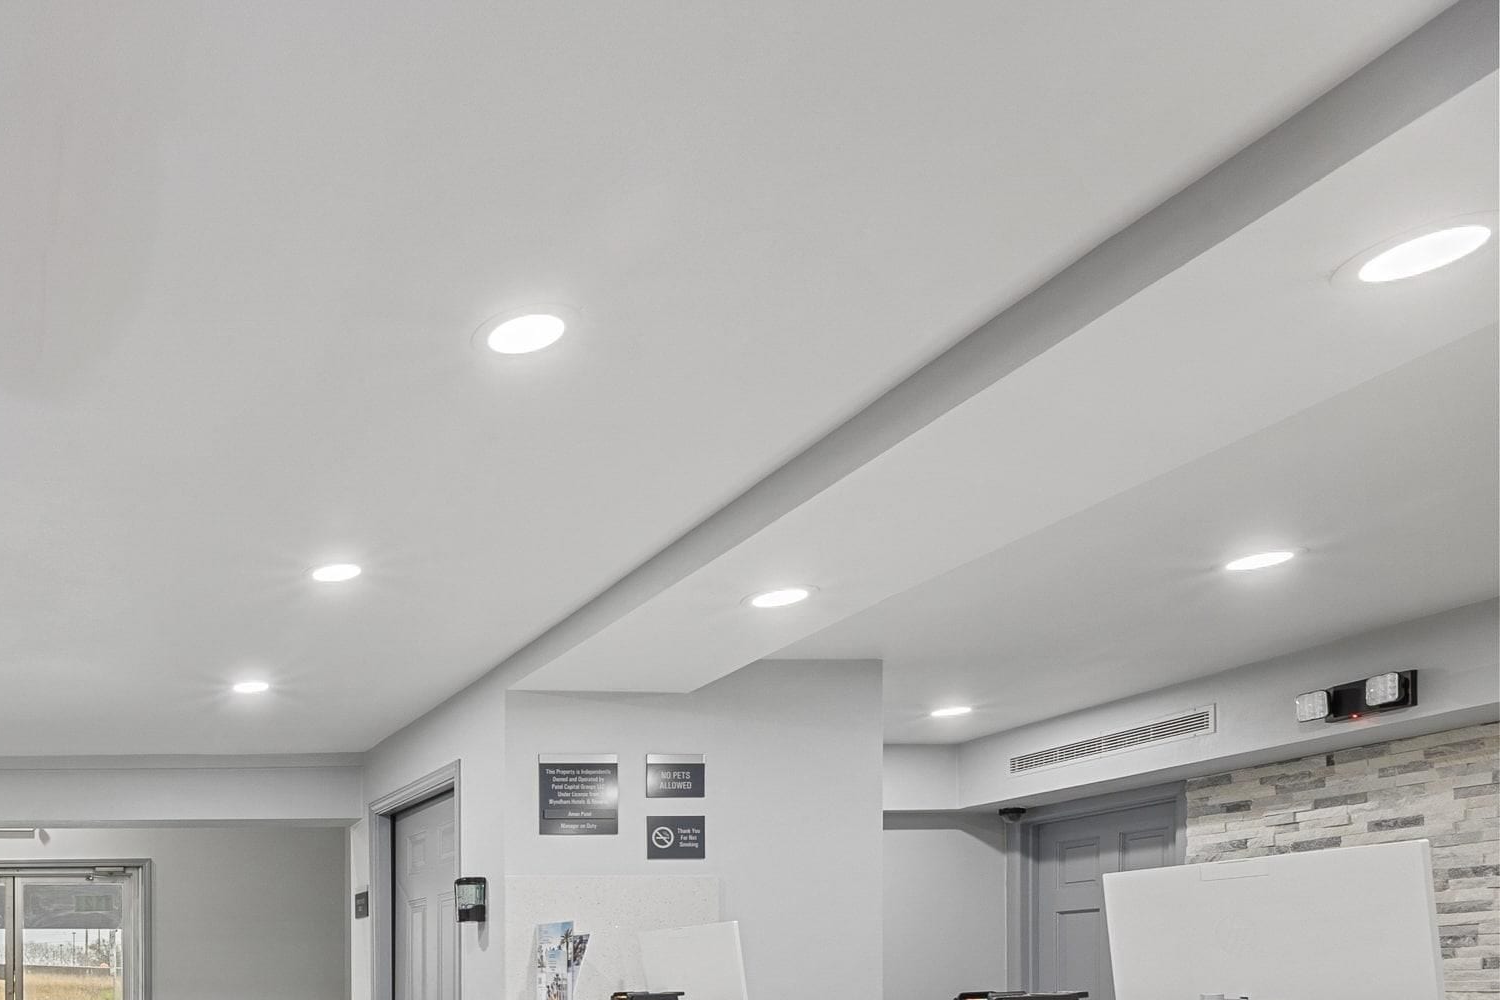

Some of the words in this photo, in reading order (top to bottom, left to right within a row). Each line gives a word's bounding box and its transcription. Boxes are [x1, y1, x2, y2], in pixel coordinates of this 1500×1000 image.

[661, 771, 671, 780] NO
[673, 771, 691, 780] PETS
[578, 776, 598, 784] Operated
[660, 781, 692, 790] ALLOWED
[679, 841, 699, 849] Smoking
